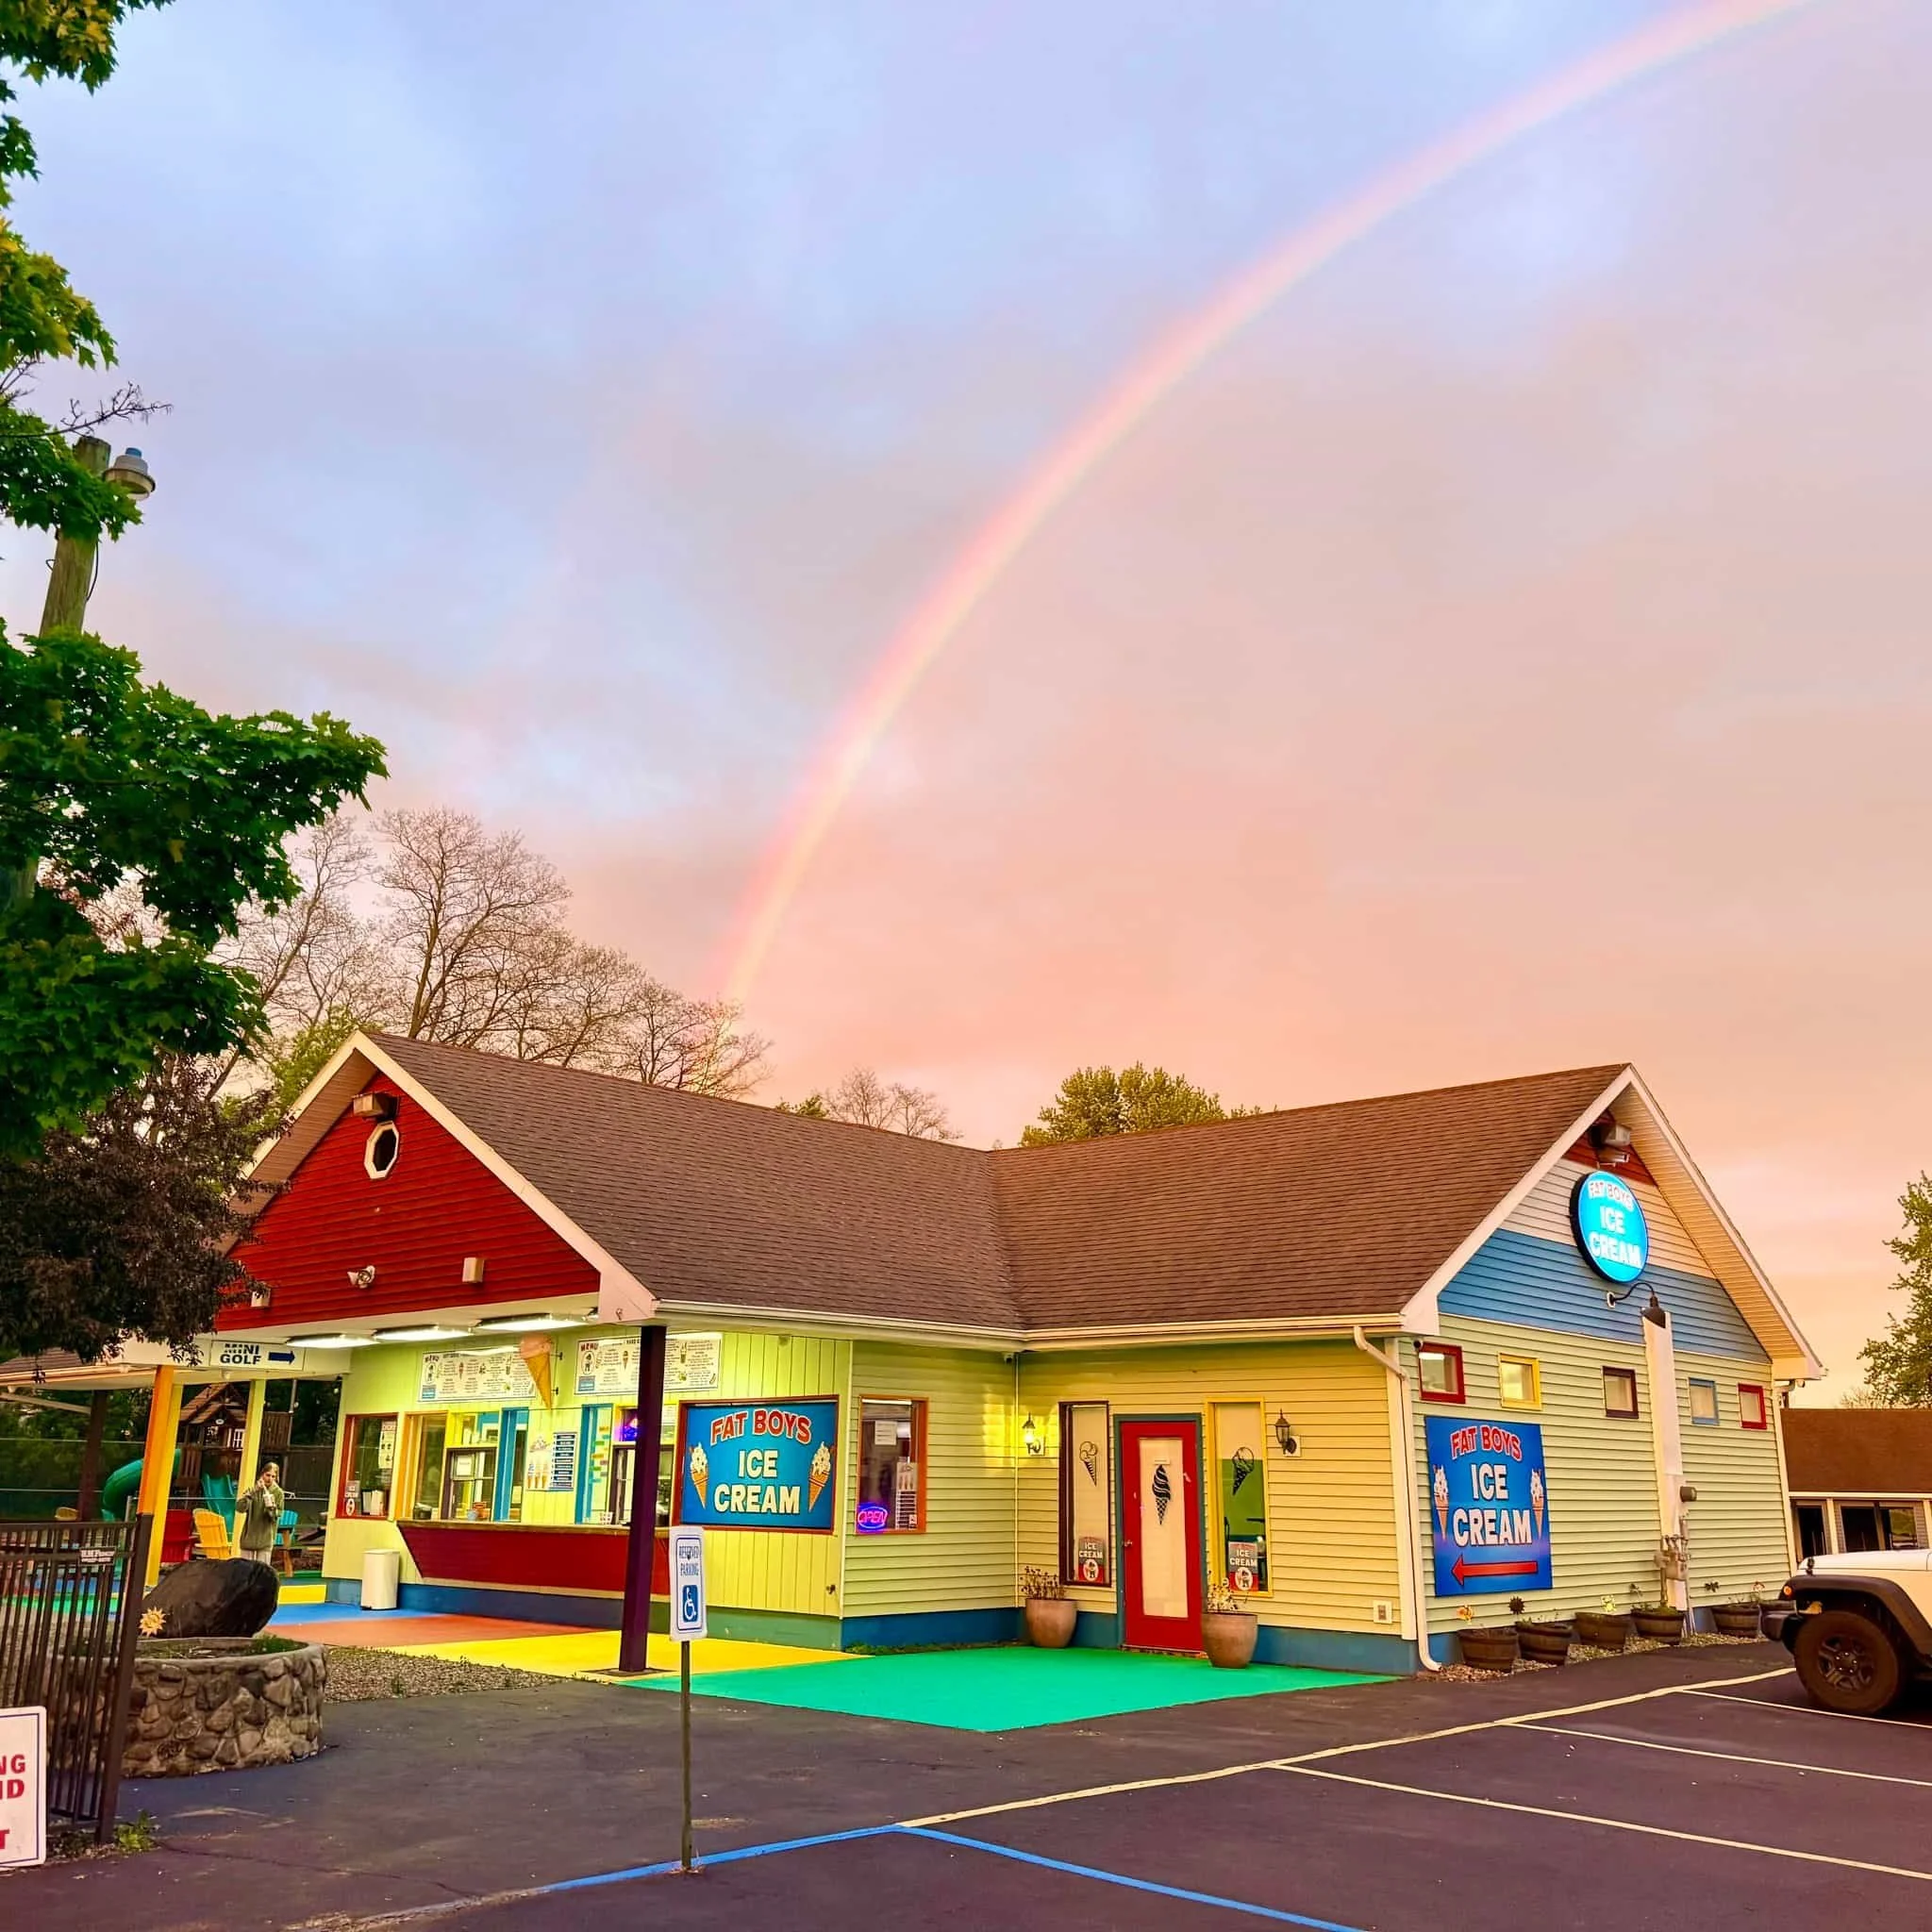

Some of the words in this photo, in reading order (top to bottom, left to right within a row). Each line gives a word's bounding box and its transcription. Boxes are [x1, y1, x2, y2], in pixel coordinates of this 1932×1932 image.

[1588, 1180, 1605, 1199] FAT
[1606, 1182, 1634, 1212] BOYS
[1600, 1206, 1625, 1235] ICE
[1589, 1231, 1642, 1270] CREAM
[220, 1354, 261, 1365] GOLF
[710, 1411, 748, 1446] FAT
[752, 1408, 812, 1444] BOYS
[1450, 1425, 1477, 1460] FAT
[1479, 1424, 1523, 1461] BOYS
[738, 1449, 778, 1478] ICE
[1471, 1463, 1508, 1500] ICE
[714, 1484, 801, 1514] CREAM
[858, 1511, 885, 1523] OPEN
[1453, 1508, 1533, 1547] CREAM
[1078, 1550, 1103, 1558] CREAM
[1085, 1541, 1097, 1550] ICE
[1237, 1549, 1250, 1557] ICE
[1229, 1557, 1257, 1567] CREAM
